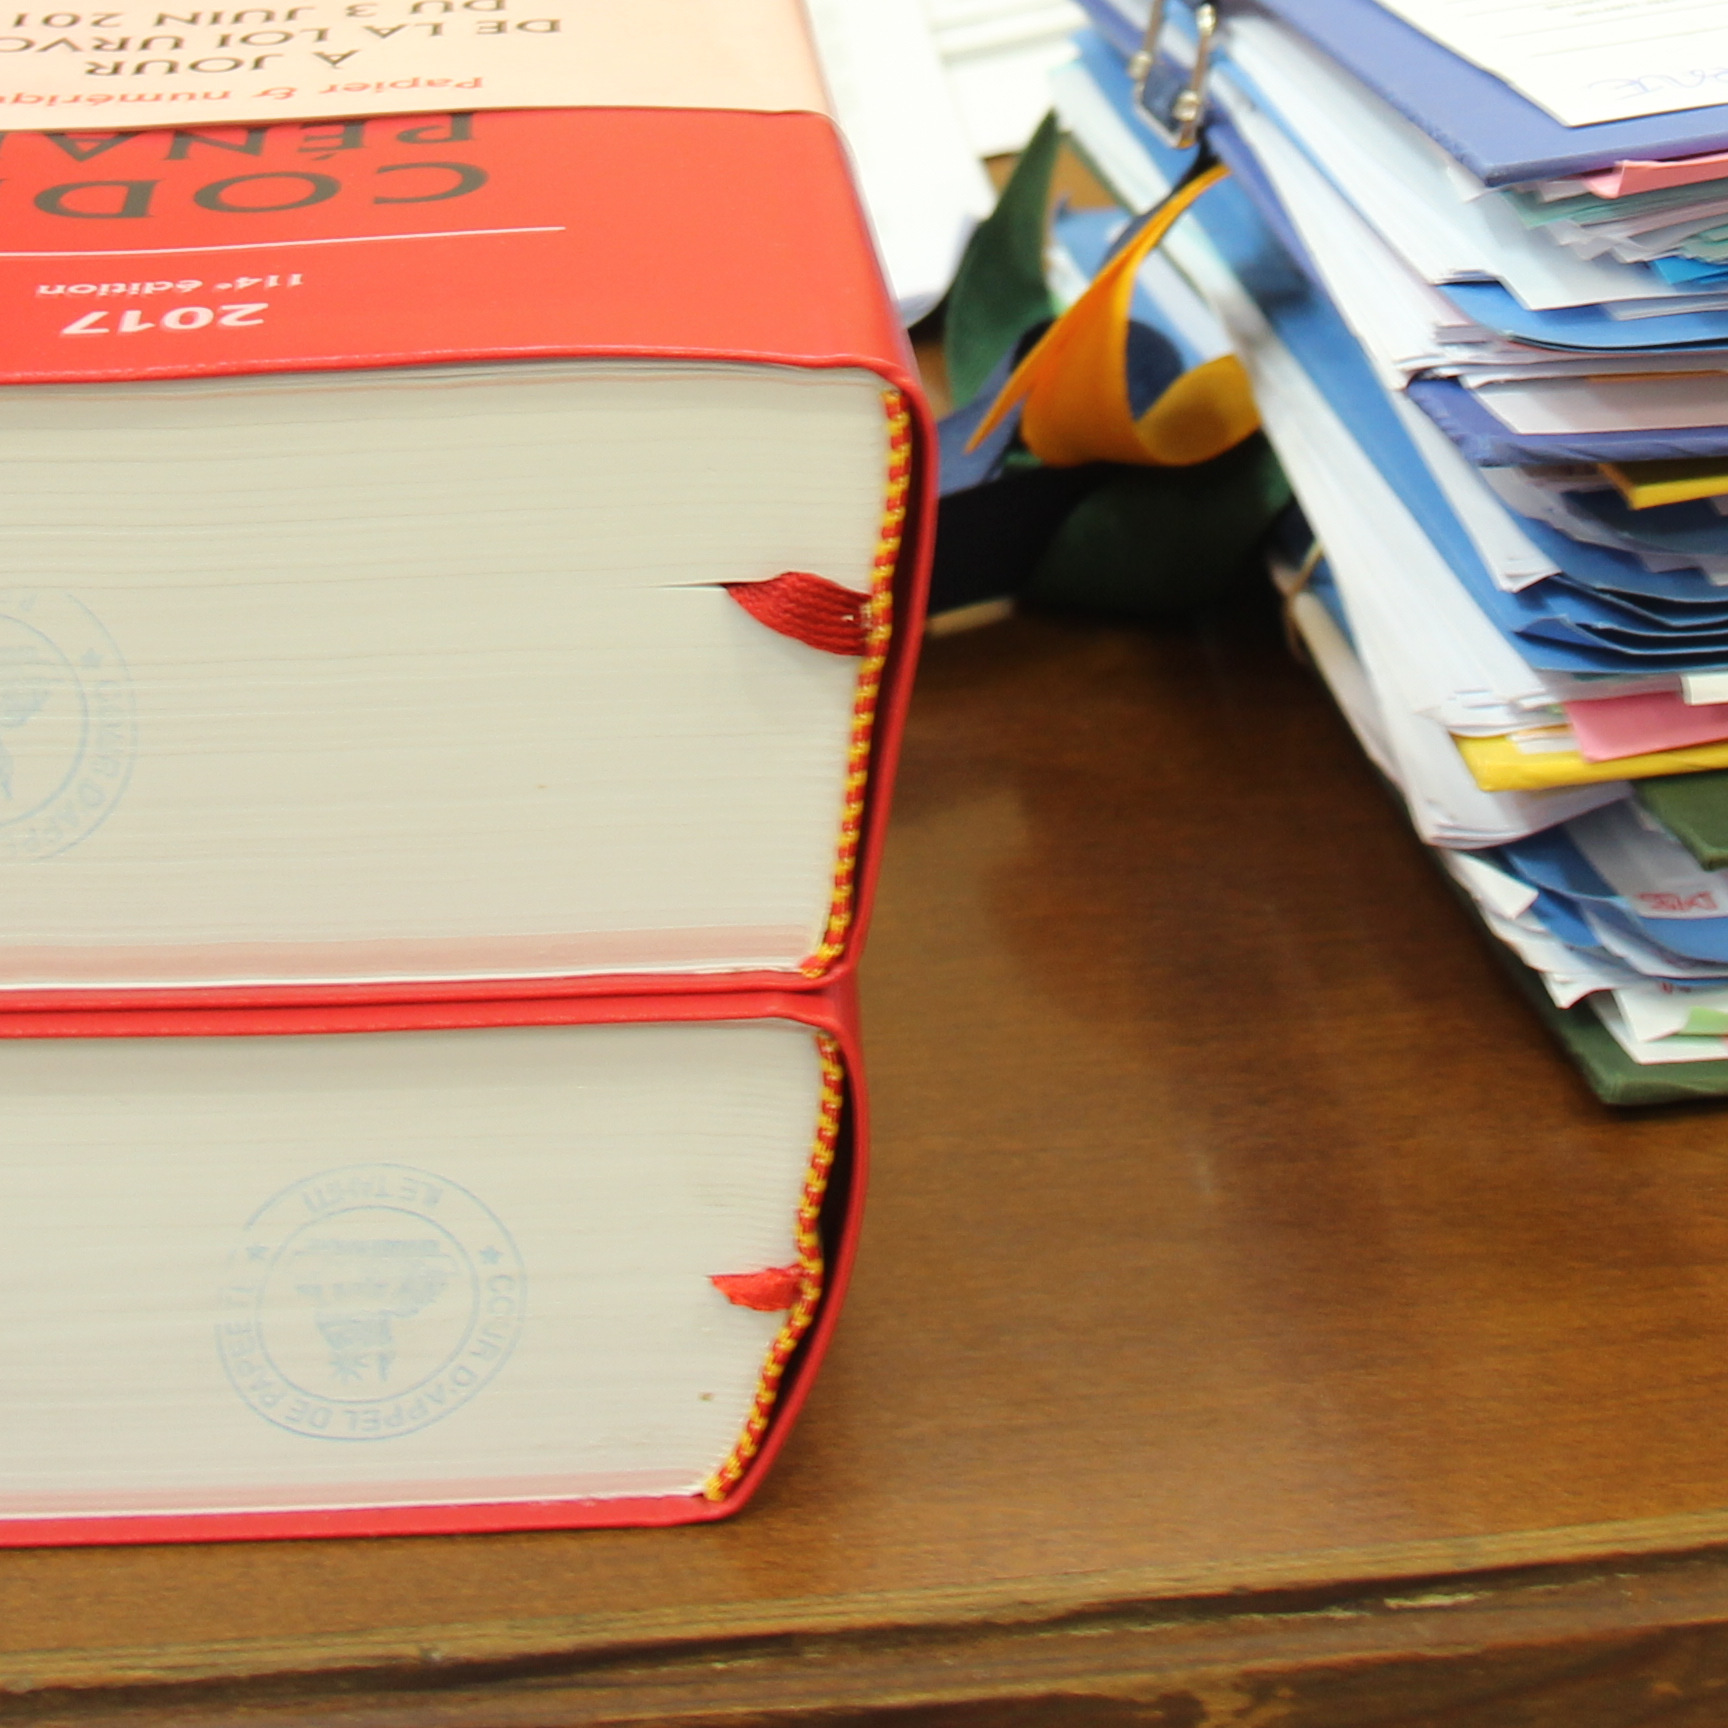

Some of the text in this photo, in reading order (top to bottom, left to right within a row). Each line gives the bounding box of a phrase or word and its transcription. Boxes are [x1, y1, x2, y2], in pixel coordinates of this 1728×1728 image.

[153, 6, 315, 28] JUIN
[345, 2, 379, 19] 3
[363, 21, 444, 41] LA
[475, 17, 562, 36] DE
[217, 27, 331, 50] LOI
[84, 48, 360, 79] À JOUR
[251, 86, 297, 103] &
[319, 75, 486, 97] Papier
[36, 276, 204, 298] édition
[59, 301, 270, 339] 2017
